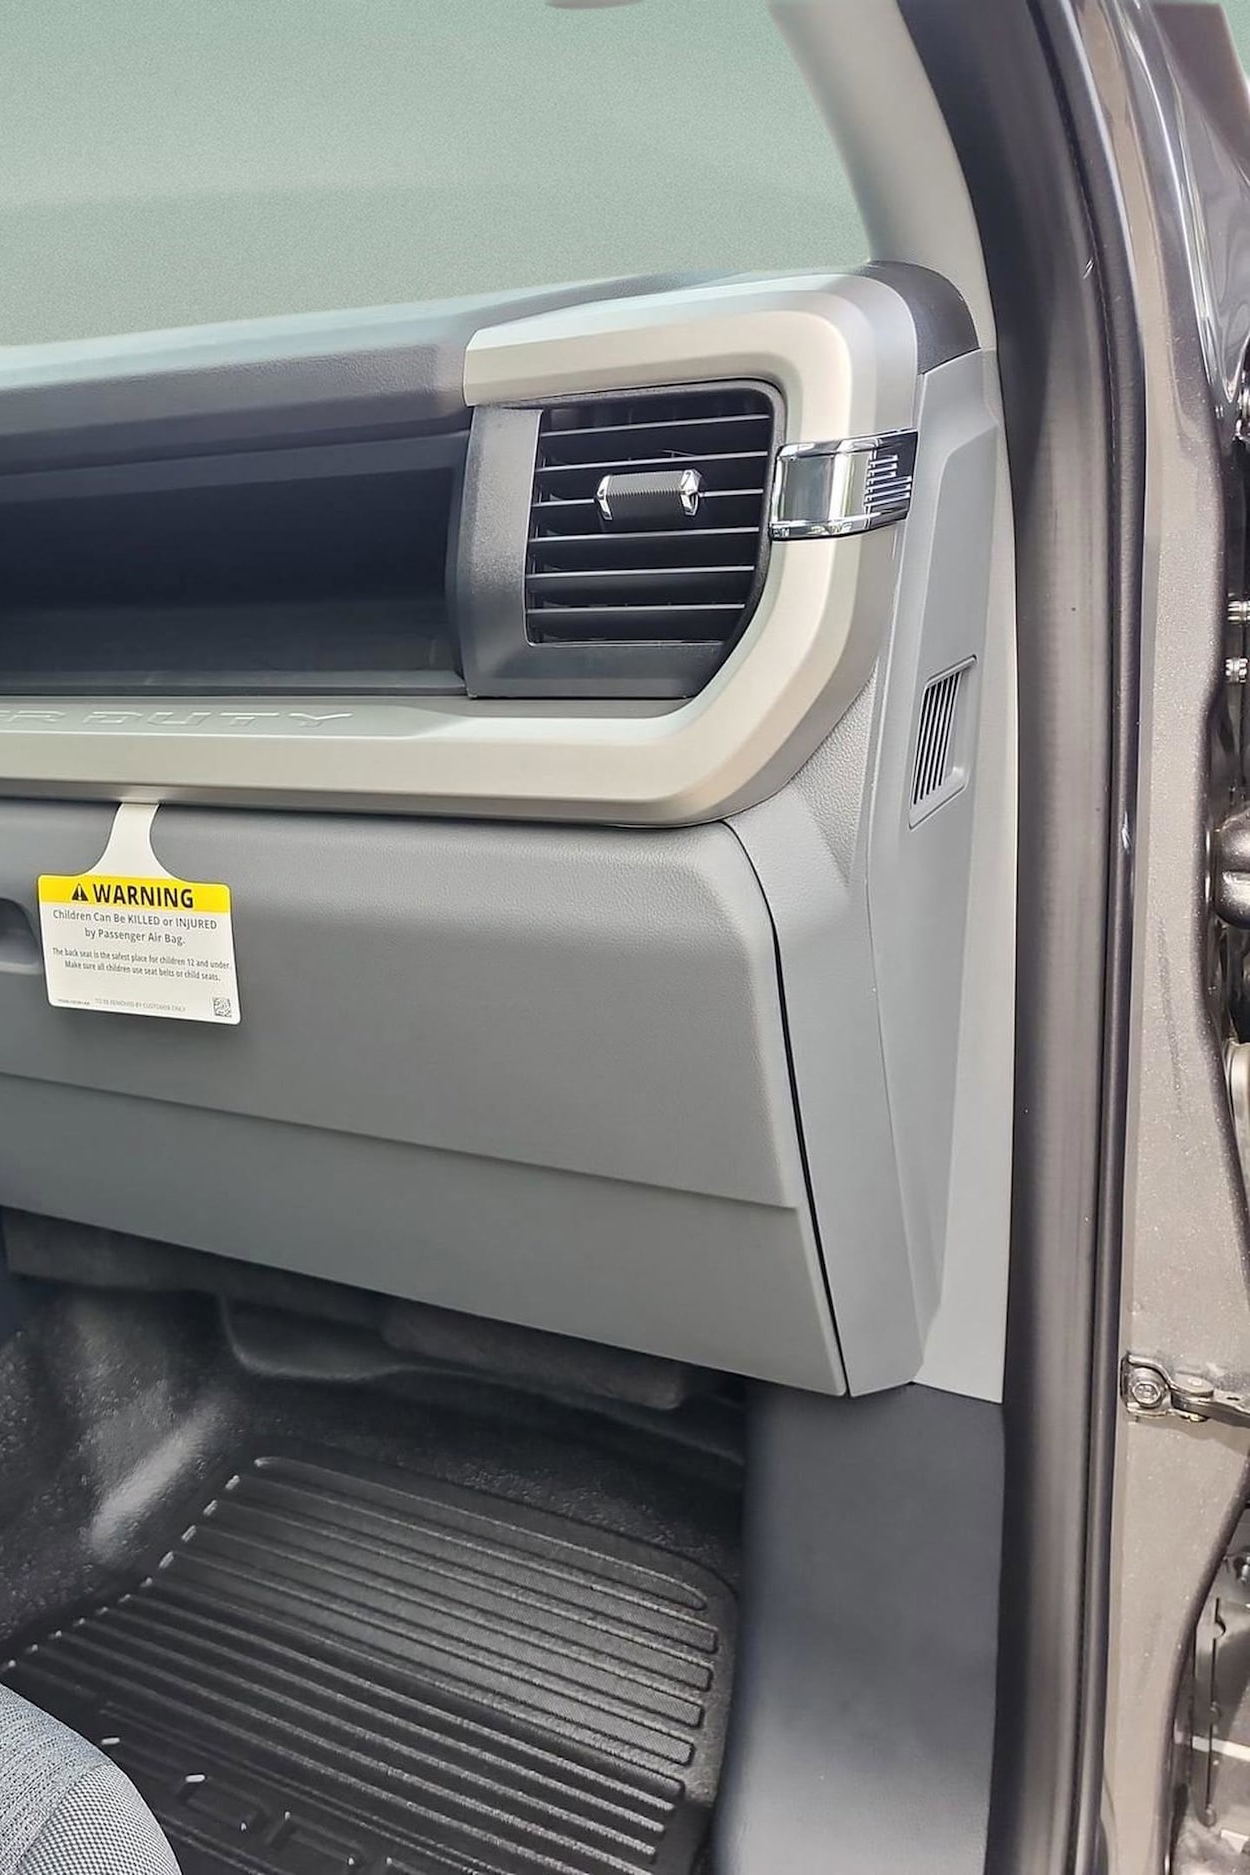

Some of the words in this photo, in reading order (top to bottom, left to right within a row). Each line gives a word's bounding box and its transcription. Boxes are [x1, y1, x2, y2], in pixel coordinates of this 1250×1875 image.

[92, 883, 194, 909] WARNING
[52, 909, 92, 921] Children
[93, 912, 111, 923] Can
[113, 913, 126, 924] Be
[127, 914, 160, 926] KILLED
[162, 918, 173, 927] or
[175, 918, 218, 930] INJURED
[84, 927, 96, 940] by
[98, 929, 145, 943] Passenger
[148, 932, 162, 943] Air
